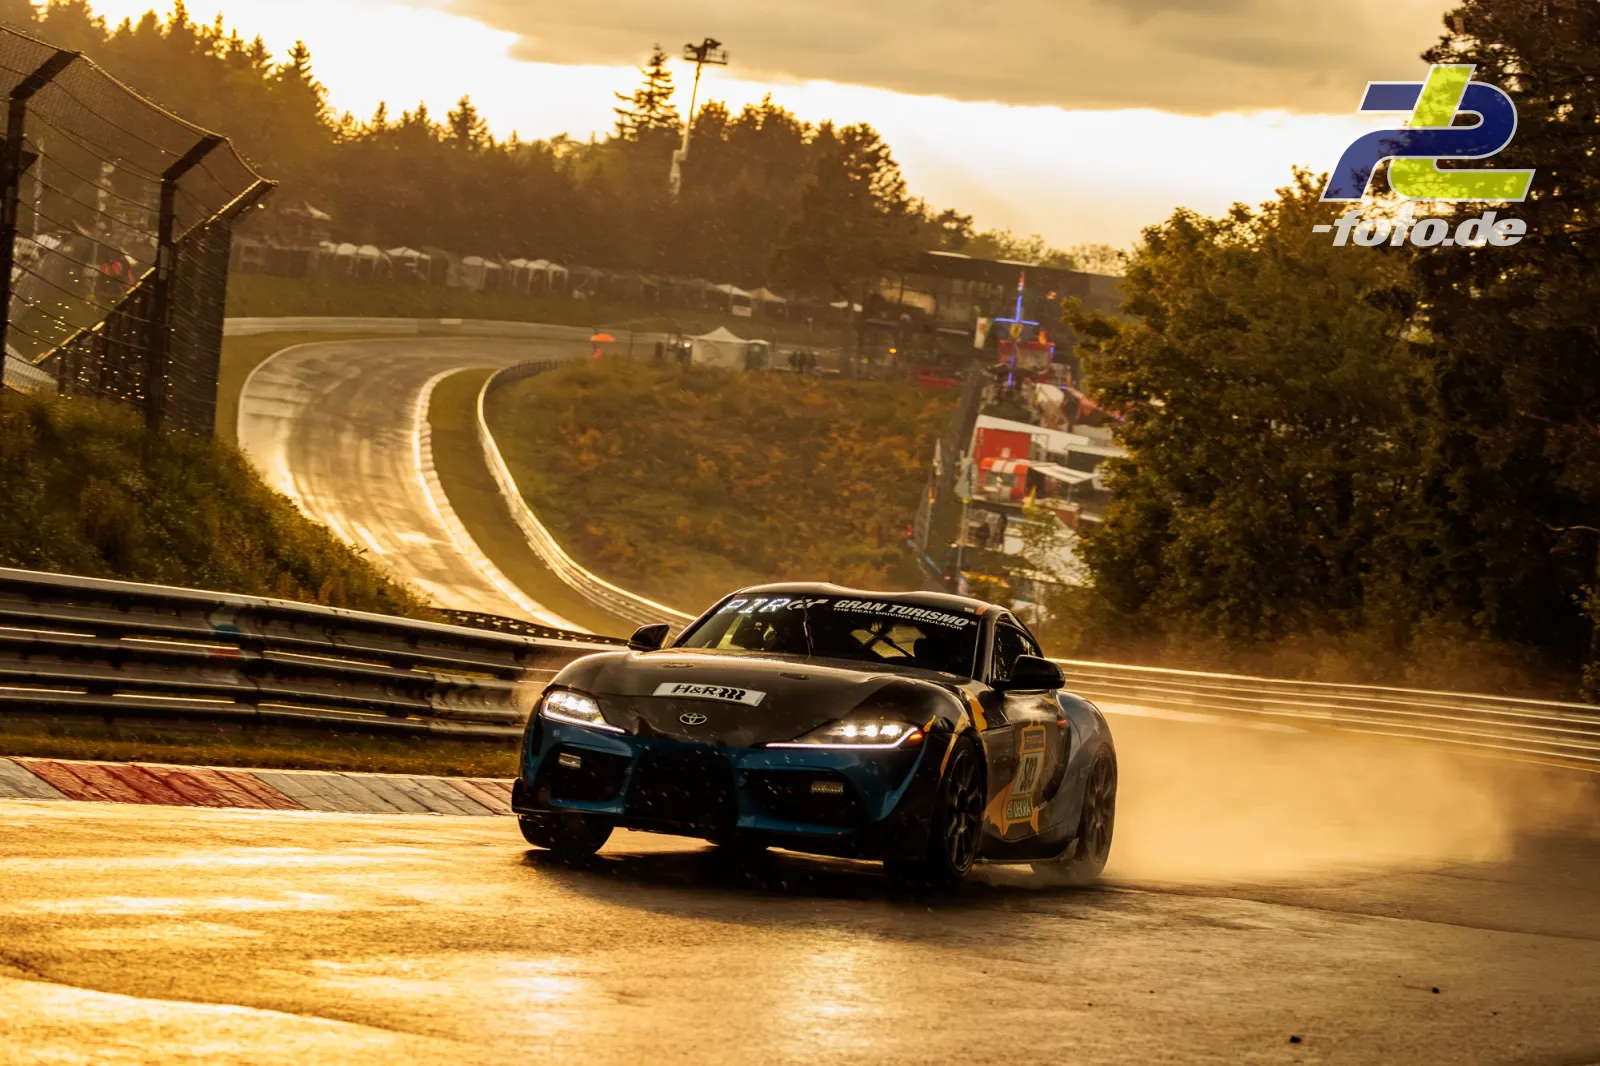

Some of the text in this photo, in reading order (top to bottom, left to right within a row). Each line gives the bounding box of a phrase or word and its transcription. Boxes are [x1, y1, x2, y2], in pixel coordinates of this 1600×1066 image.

[833, 599, 888, 612] GRAN
[875, 611, 911, 620] DRIVING
[912, 616, 963, 631] SIMULATOR
[671, 684, 718, 696] H&R
